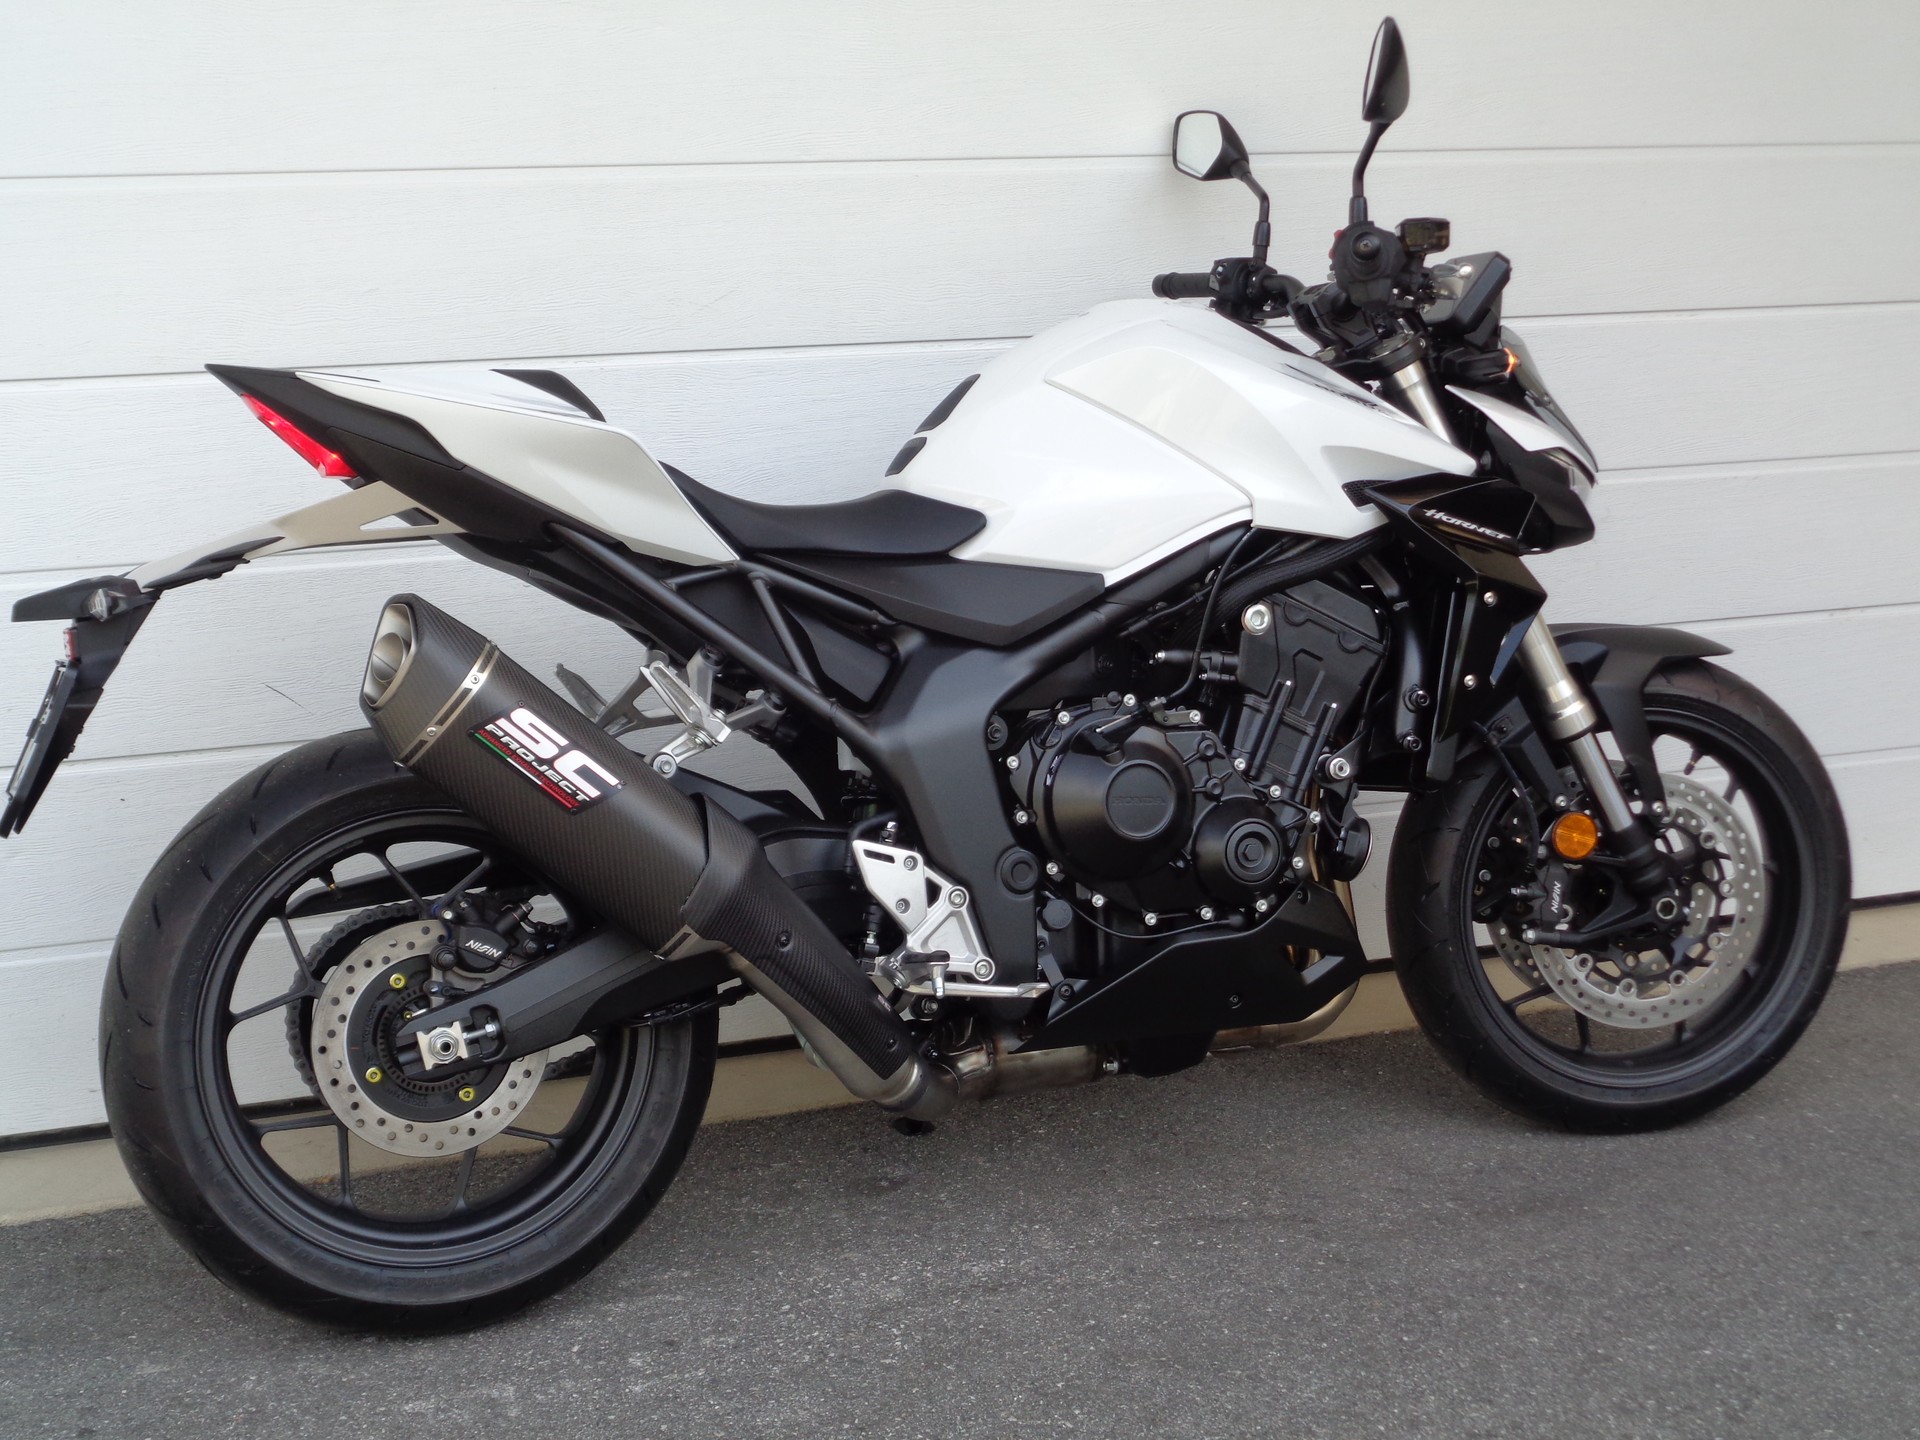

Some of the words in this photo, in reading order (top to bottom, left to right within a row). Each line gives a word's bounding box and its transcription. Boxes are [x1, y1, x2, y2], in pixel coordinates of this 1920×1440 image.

[479, 729, 512, 755] ADVANCED
[512, 754, 539, 776] EXHAUST
[540, 775, 580, 806] TECHNOLOGY
[484, 723, 590, 801] PROJECT
[495, 708, 619, 798] SC
[465, 940, 502, 957] NISSIN
